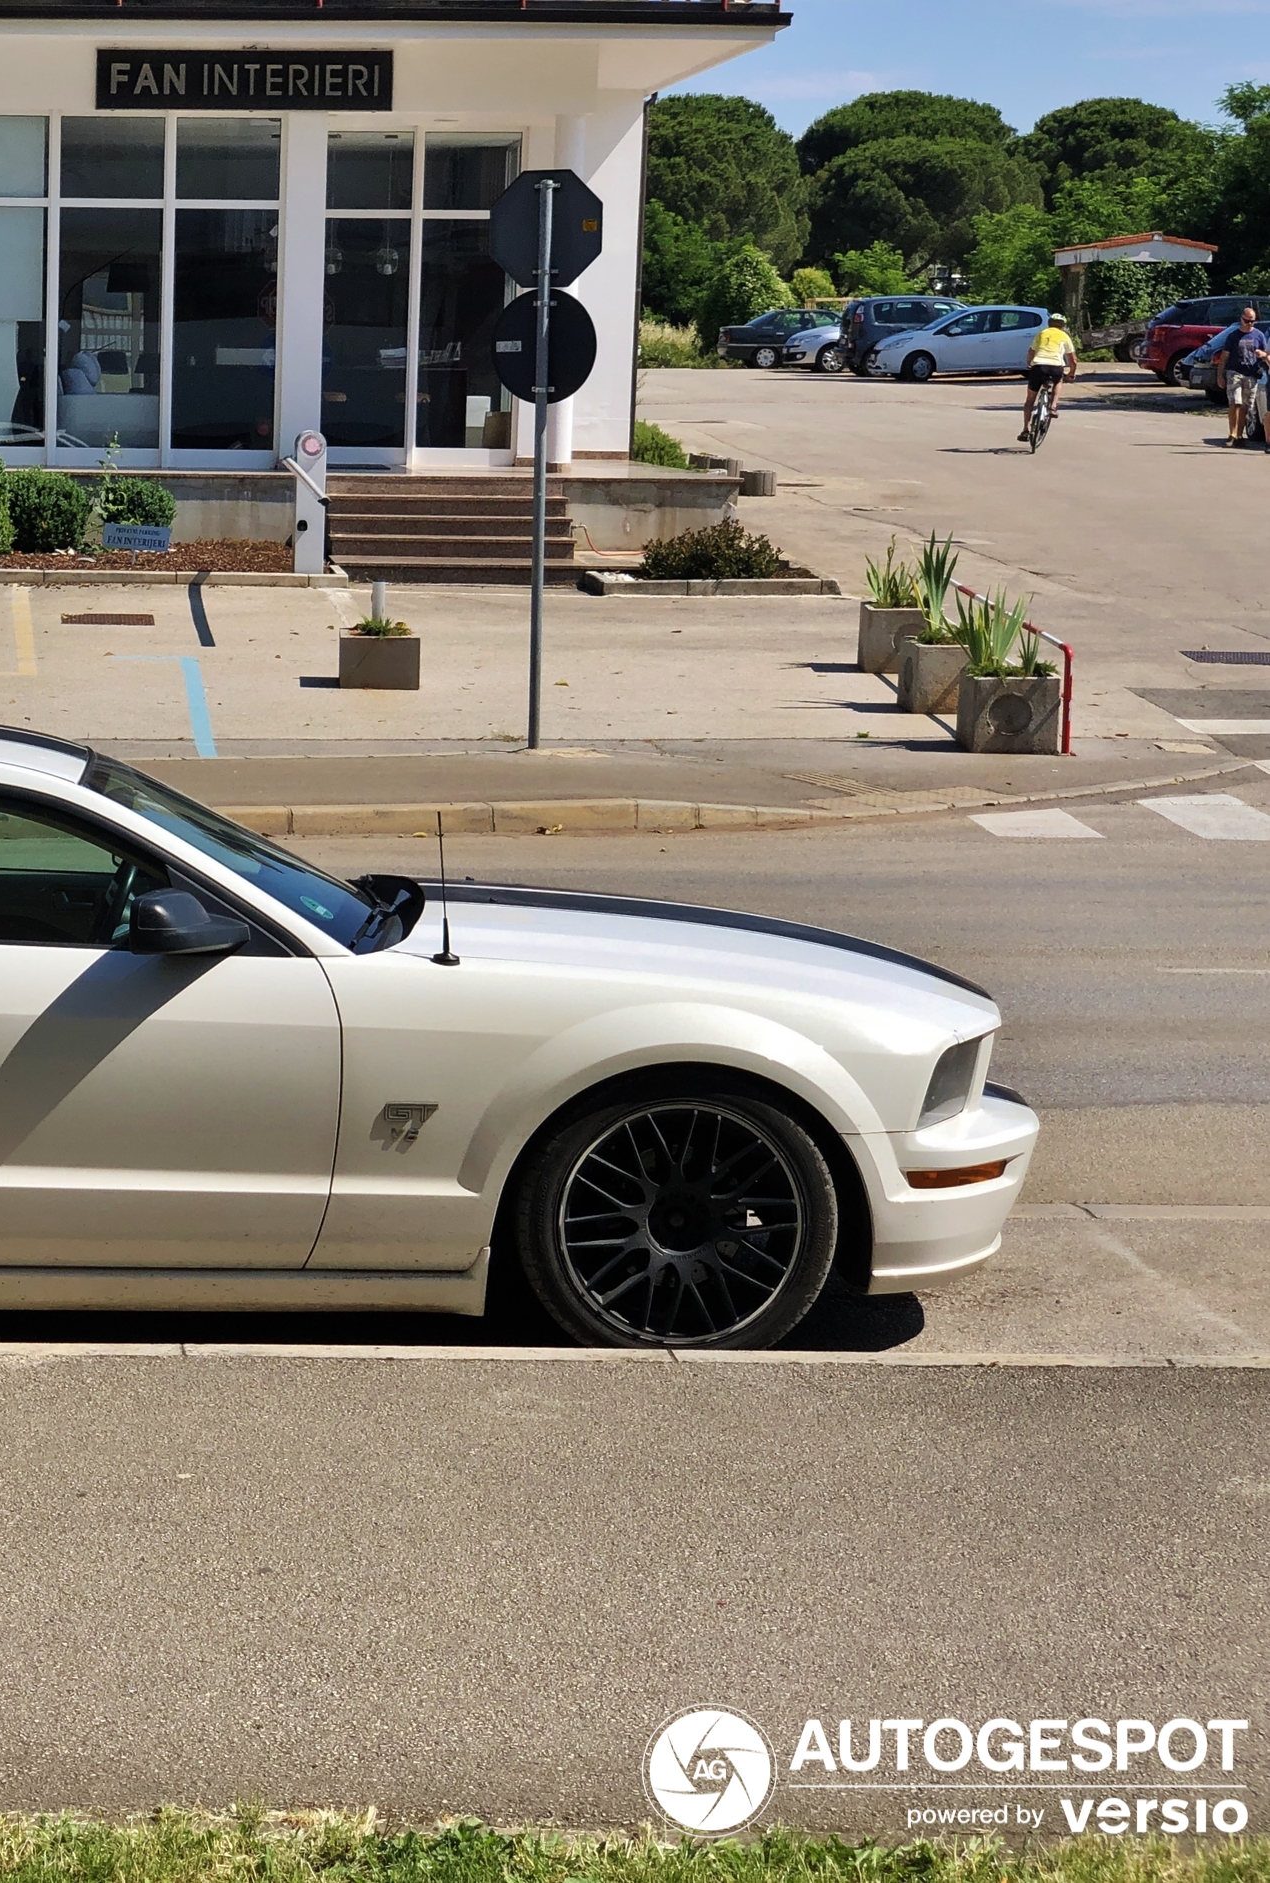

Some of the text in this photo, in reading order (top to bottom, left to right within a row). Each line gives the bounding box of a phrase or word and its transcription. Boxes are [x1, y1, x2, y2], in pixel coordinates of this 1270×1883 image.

[110, 62, 380, 97] FAN INTERIERI
[107, 535, 123, 545] FAN
[384, 1100, 439, 1123] GT
